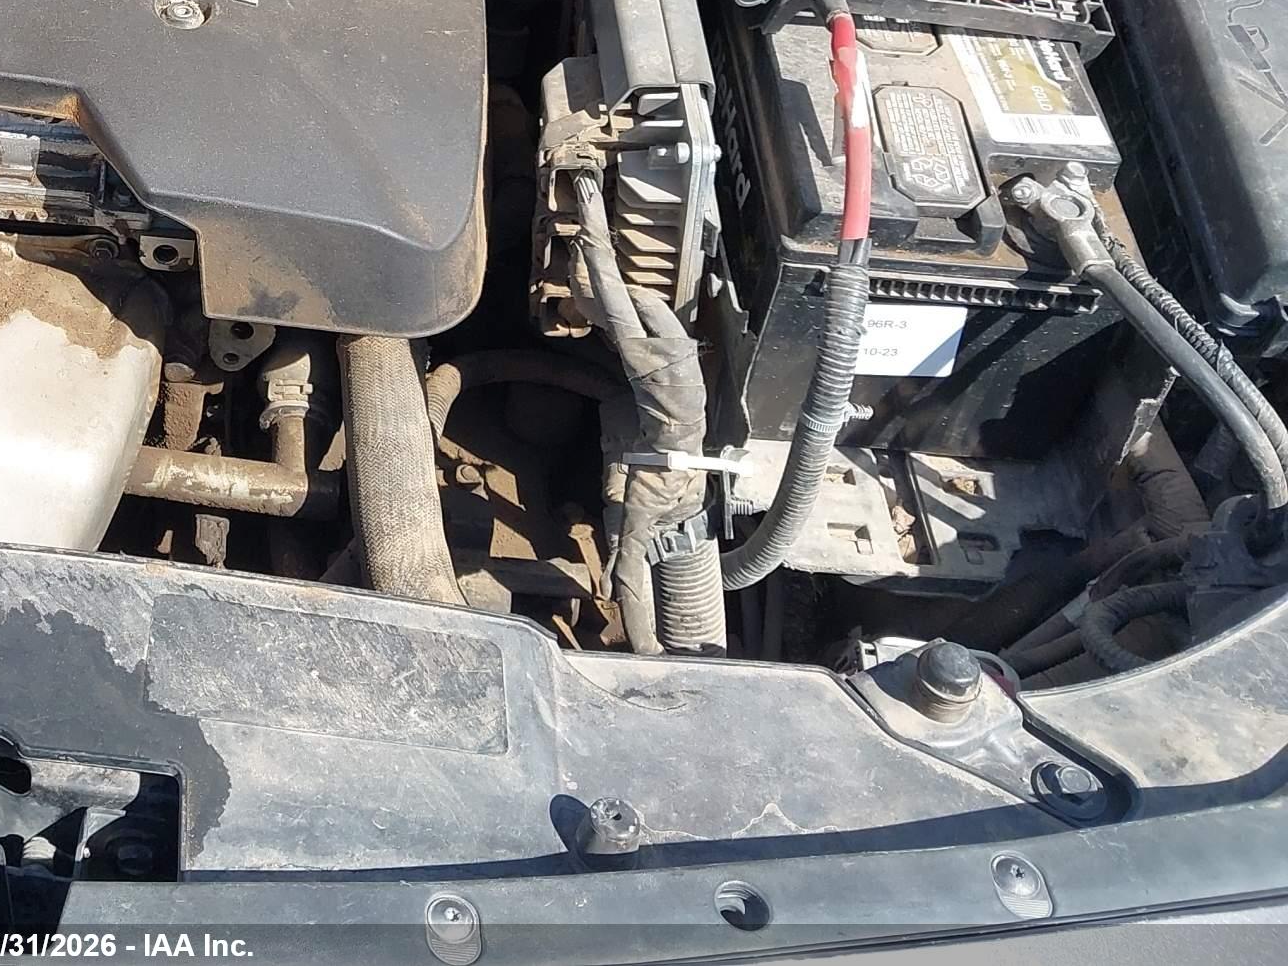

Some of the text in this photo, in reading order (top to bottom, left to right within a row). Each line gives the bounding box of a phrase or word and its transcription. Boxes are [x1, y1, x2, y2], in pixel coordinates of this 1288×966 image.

[1035, 39, 1073, 81] ieHard
[1030, 84, 1054, 113] GOLD
[867, 320, 907, 329] 96R-3
[863, 348, 898, 357] 10-23
